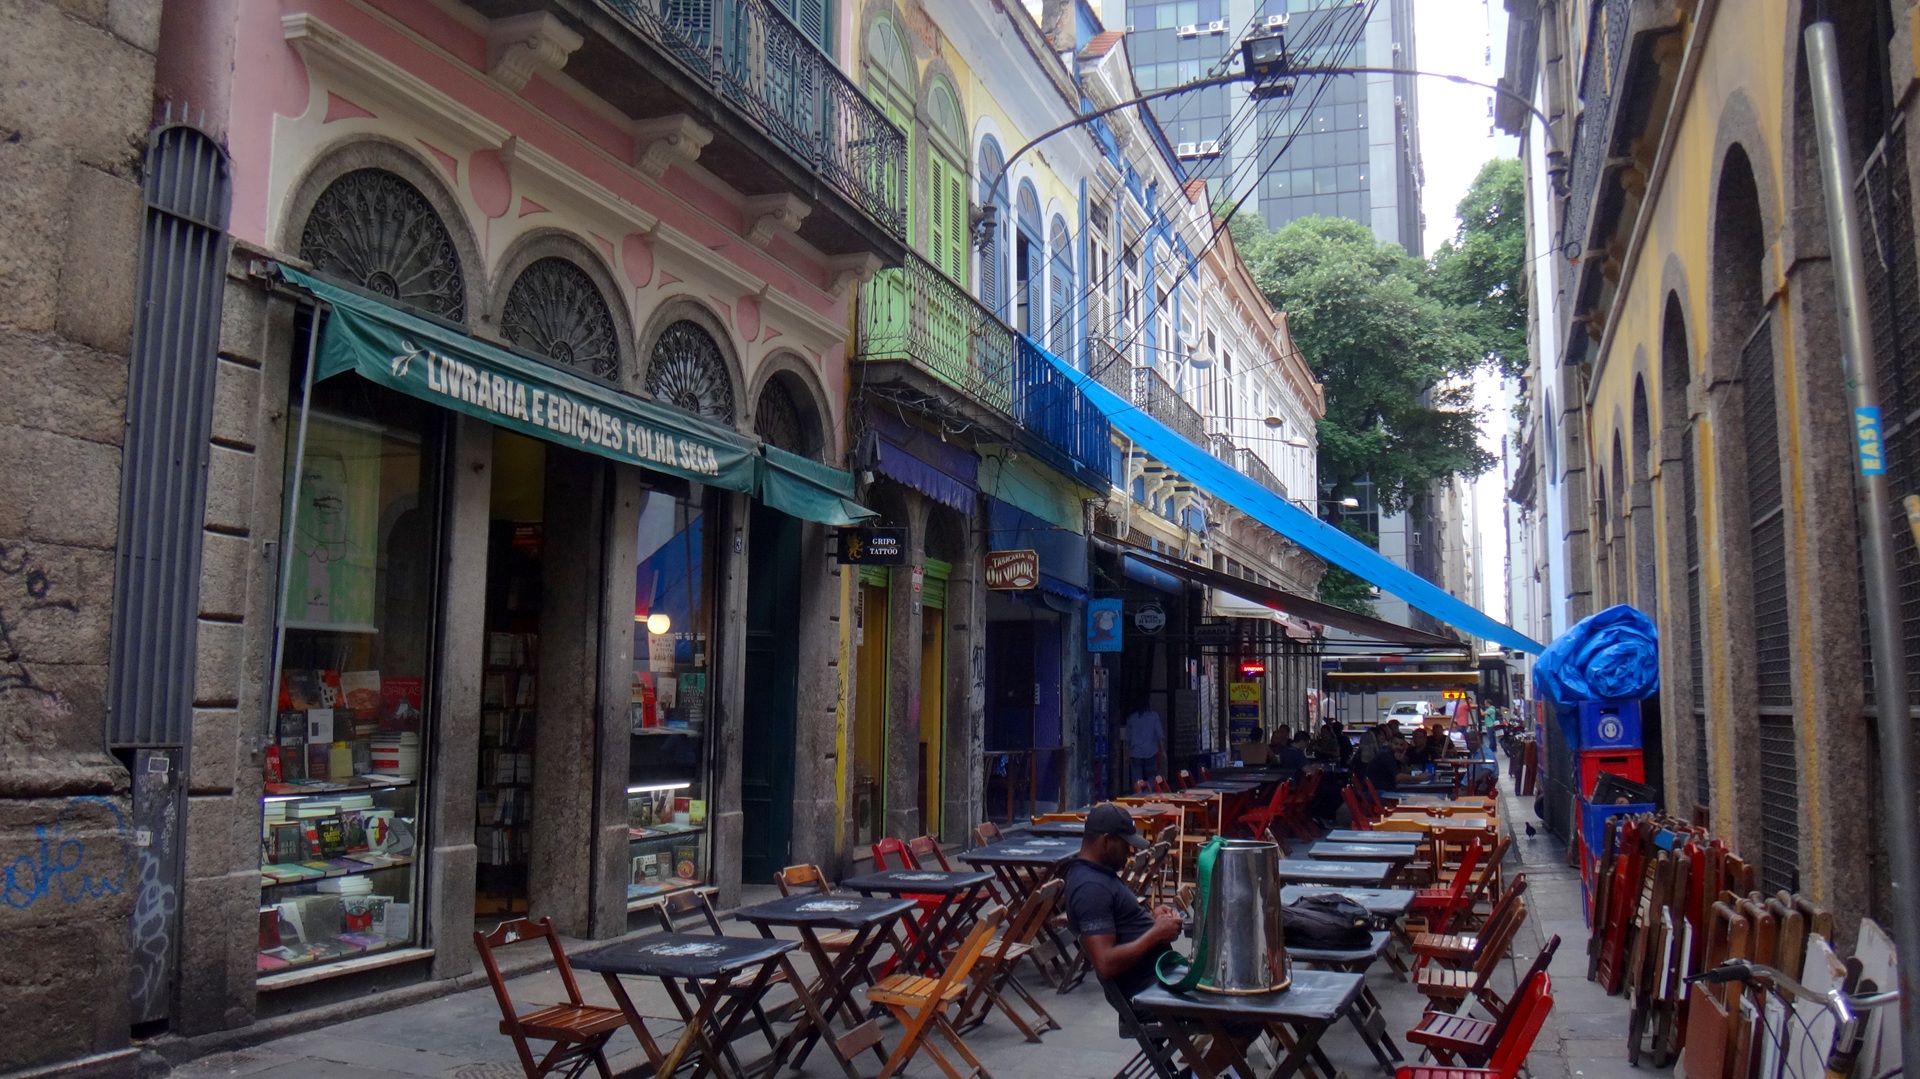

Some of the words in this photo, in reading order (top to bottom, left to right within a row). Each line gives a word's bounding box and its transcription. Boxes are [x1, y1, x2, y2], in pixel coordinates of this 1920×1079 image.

[427, 350, 529, 421] LIVRARIA
[532, 389, 545, 426] E
[547, 394, 623, 450] EDIÇÕES
[626, 421, 678, 466] FOLHA
[679, 439, 719, 476] SECA
[1856, 414, 1881, 470] EASY
[986, 561, 1034, 585] OUVIDOR
